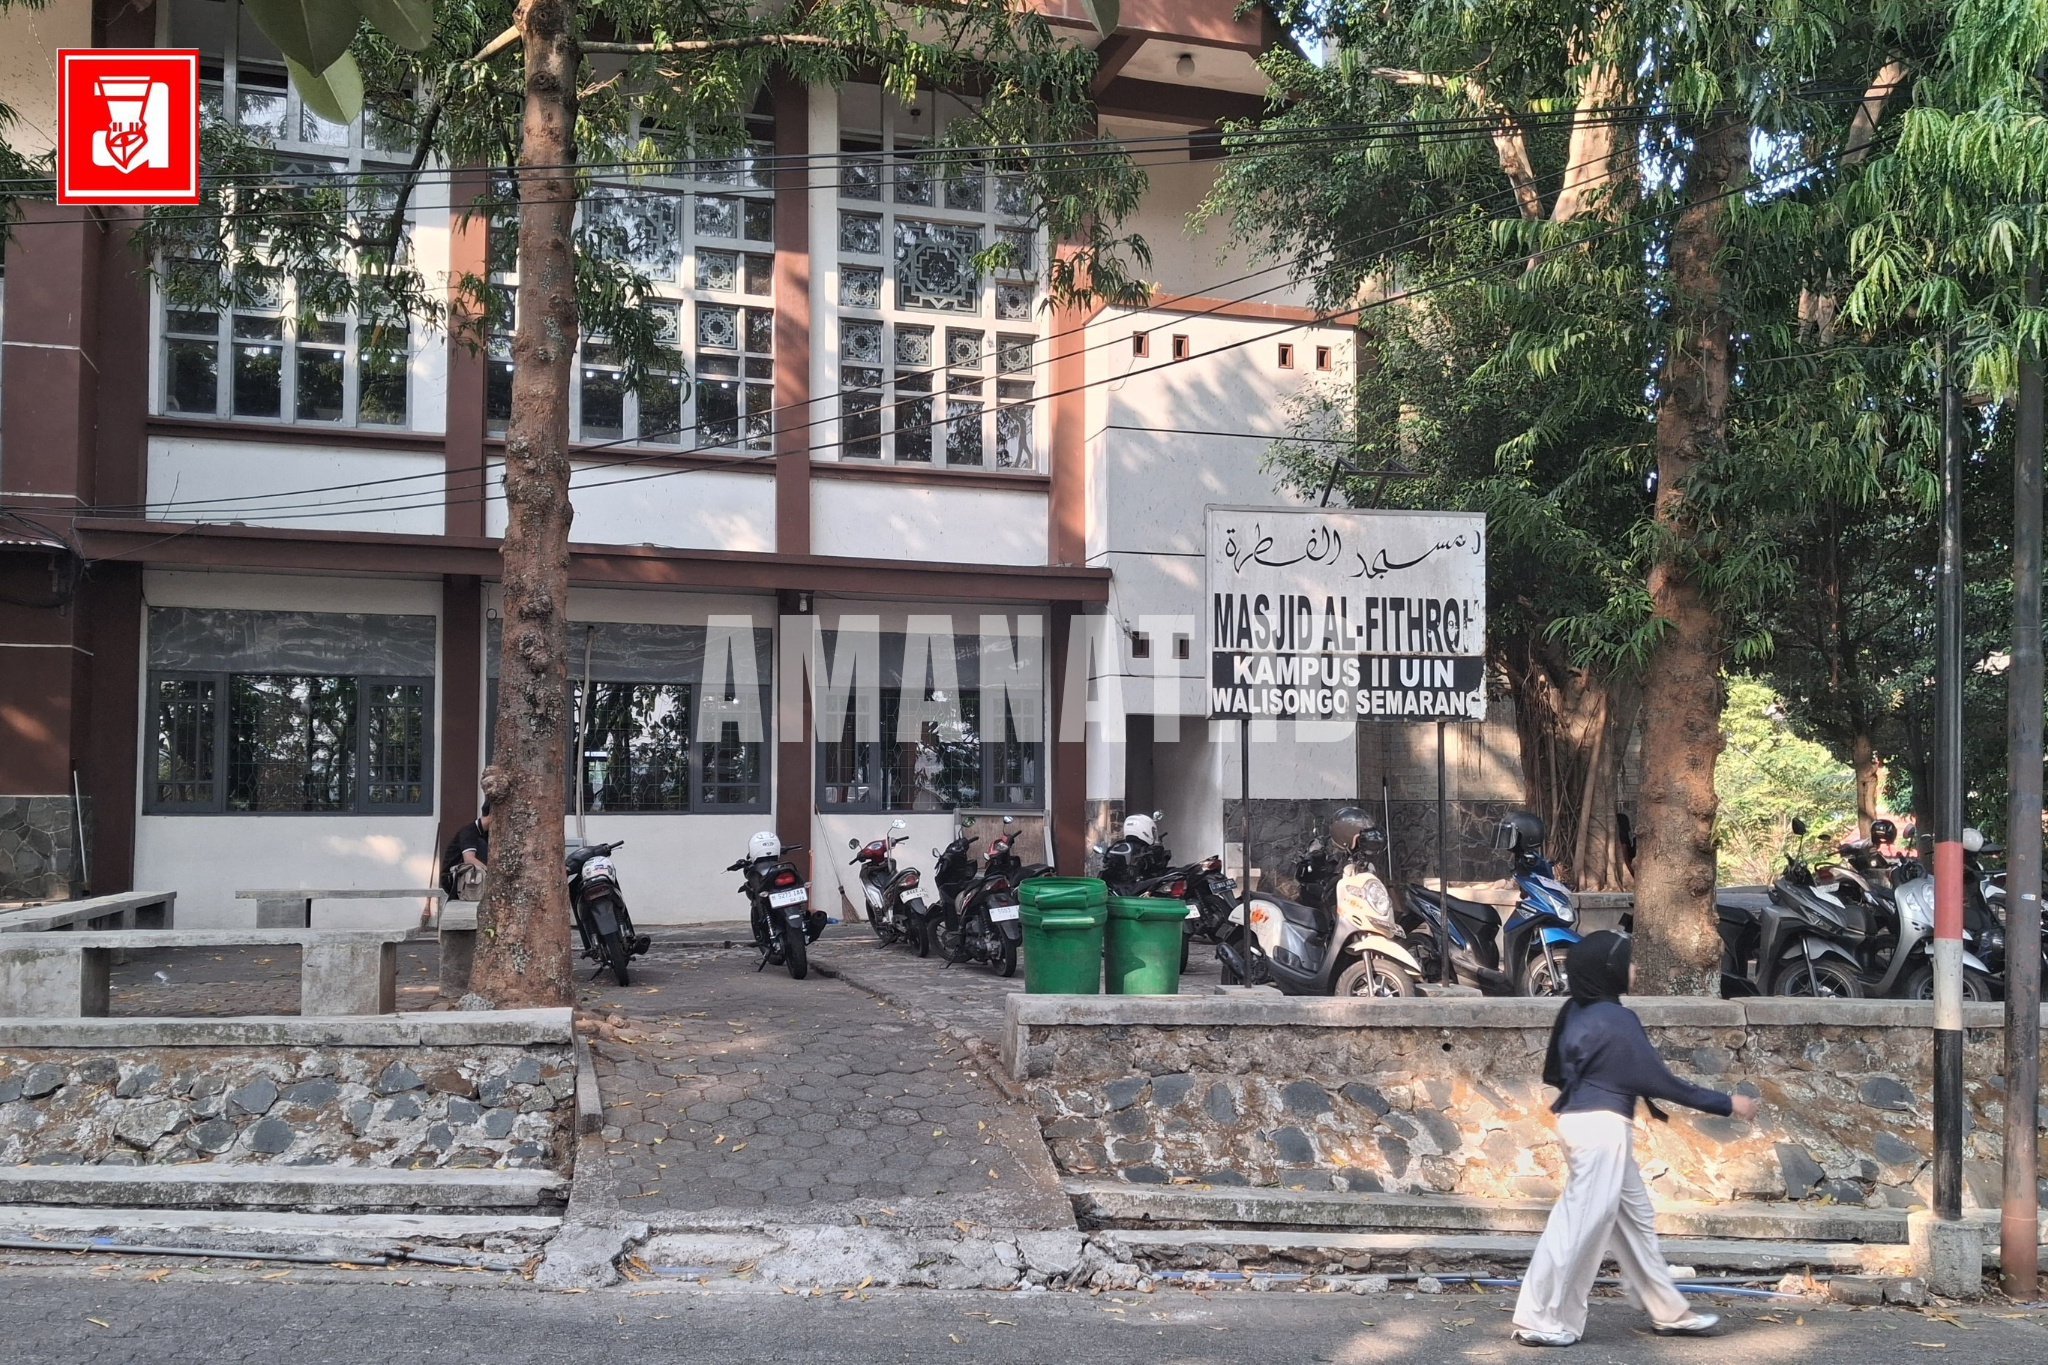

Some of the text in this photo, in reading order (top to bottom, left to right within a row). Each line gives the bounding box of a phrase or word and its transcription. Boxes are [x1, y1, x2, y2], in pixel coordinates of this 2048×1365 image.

[1214, 592, 1313, 651] MASJID
[1233, 655, 1454, 688] KAMPUS II UIN
[1212, 687, 1482, 718] WALISONGO SEMARANG
